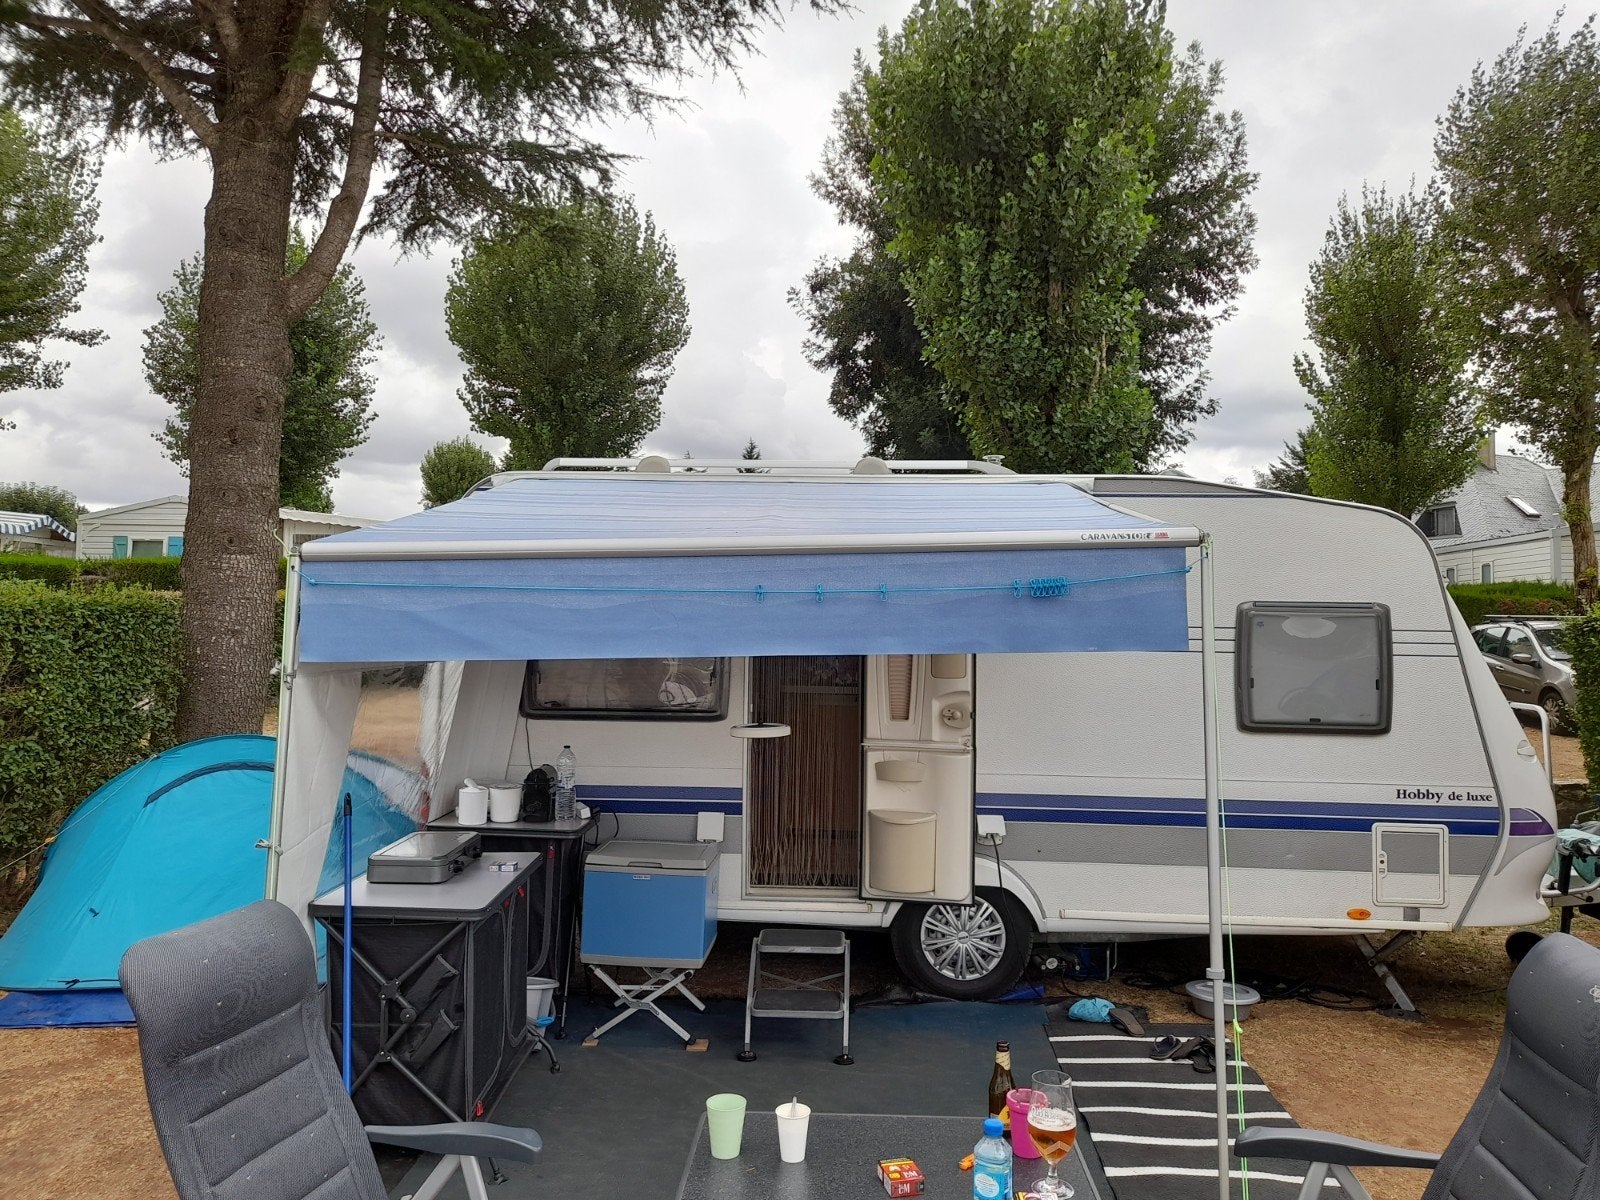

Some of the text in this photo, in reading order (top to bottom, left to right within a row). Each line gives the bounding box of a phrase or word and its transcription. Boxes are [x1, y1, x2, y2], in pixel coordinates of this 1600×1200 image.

[1396, 789, 1493, 803] Hobby de luxe
